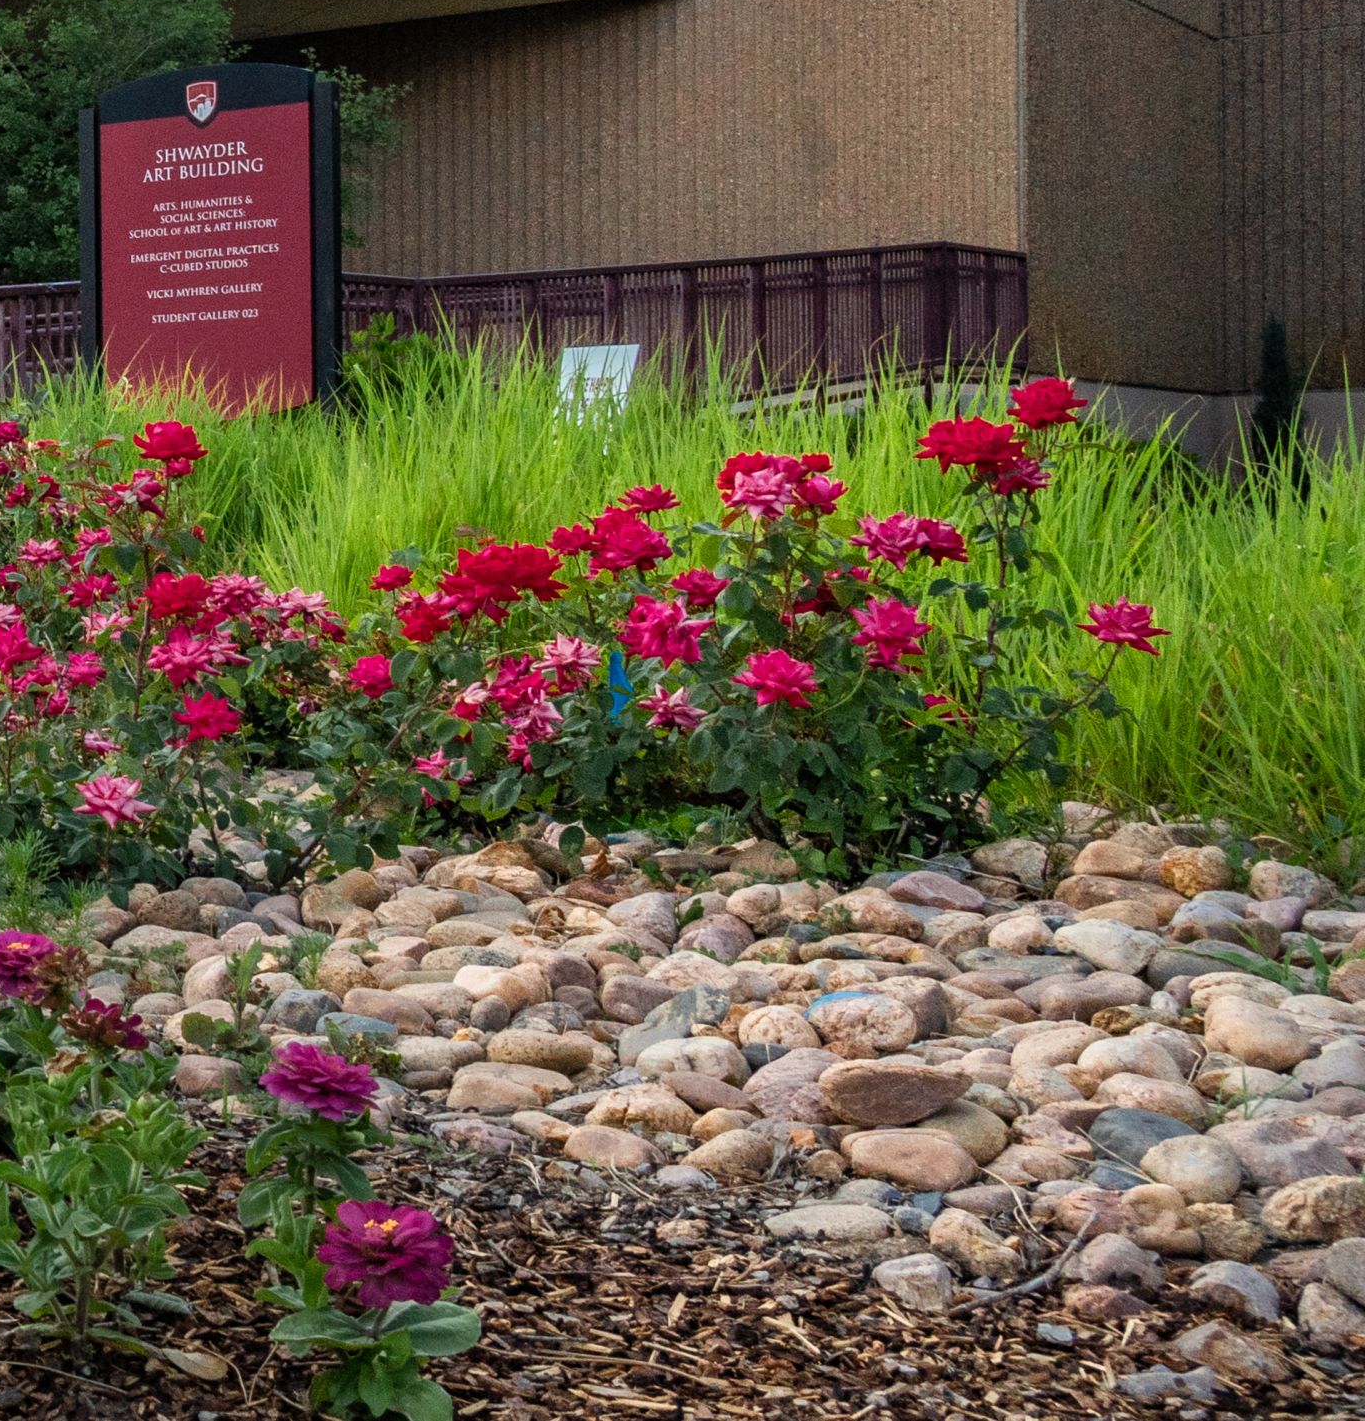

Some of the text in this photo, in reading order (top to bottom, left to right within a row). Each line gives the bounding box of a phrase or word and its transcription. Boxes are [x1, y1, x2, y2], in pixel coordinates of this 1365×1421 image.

[155, 141, 248, 164] SHWAYDER
[142, 157, 264, 183] ART BUILDING
[180, 195, 243, 210] HUMANITIES
[244, 195, 254, 205] &
[159, 208, 247, 224] SOCIAL SCIENCES:
[129, 227, 169, 239] SCHOOL
[183, 224, 202, 235] ART
[203, 223, 212, 233] &
[213, 221, 233, 232] ART
[235, 218, 279, 230] HISTORY
[130, 243, 280, 264] EMERGENT DIGITAL PRACTICES
[159, 258, 249, 274] C-CUBED STUDIOS
[146, 283, 264, 299] VICKI MYHREN GALLERY
[151, 308, 259, 324] STUDENT GALLERY 023
